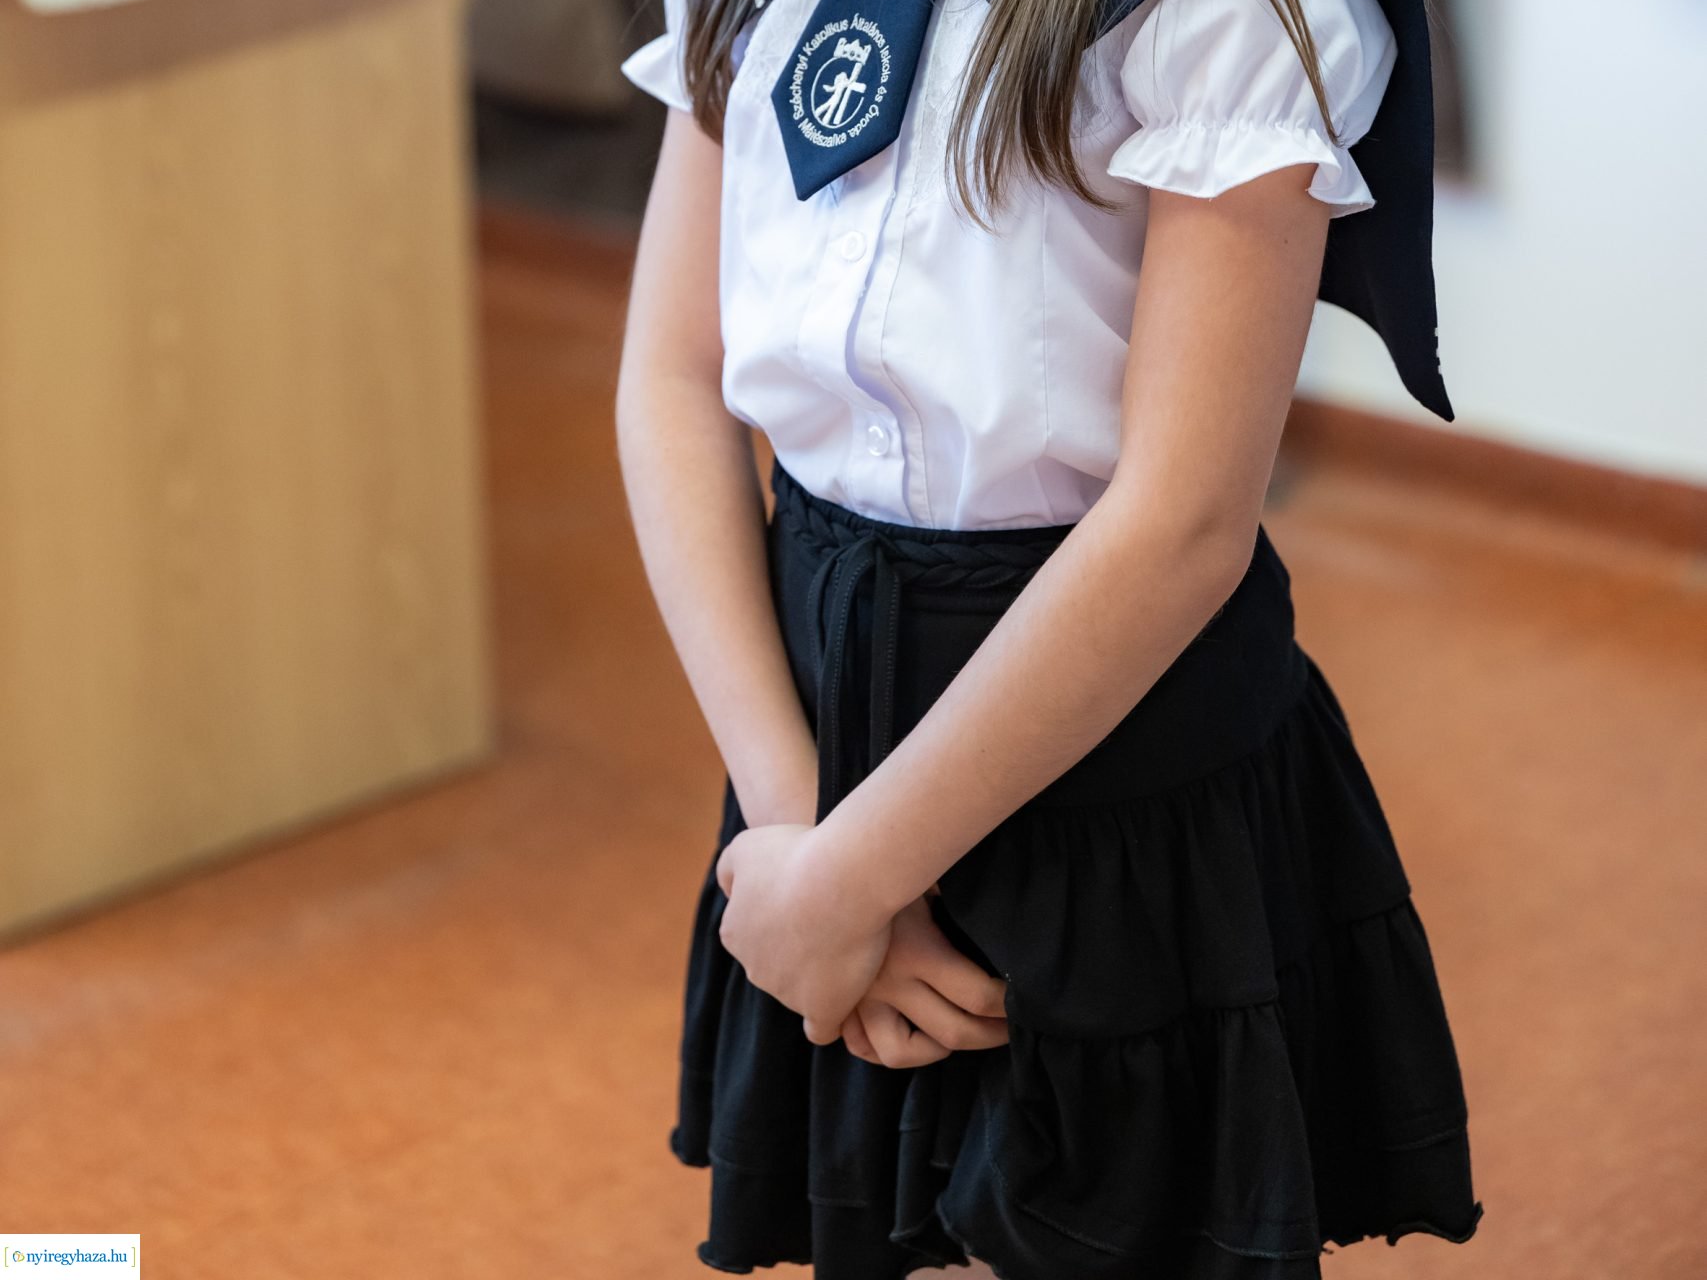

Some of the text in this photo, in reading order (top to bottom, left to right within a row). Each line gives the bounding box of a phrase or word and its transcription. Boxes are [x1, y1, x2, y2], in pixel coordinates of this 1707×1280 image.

[803, 19, 849, 56] Katolikus
[850, 13, 886, 48] Általános
[879, 45, 892, 84] Iskola
[874, 86, 888, 103] és
[798, 118, 847, 147] Mátészalka
[848, 104, 880, 138] Óvoda
